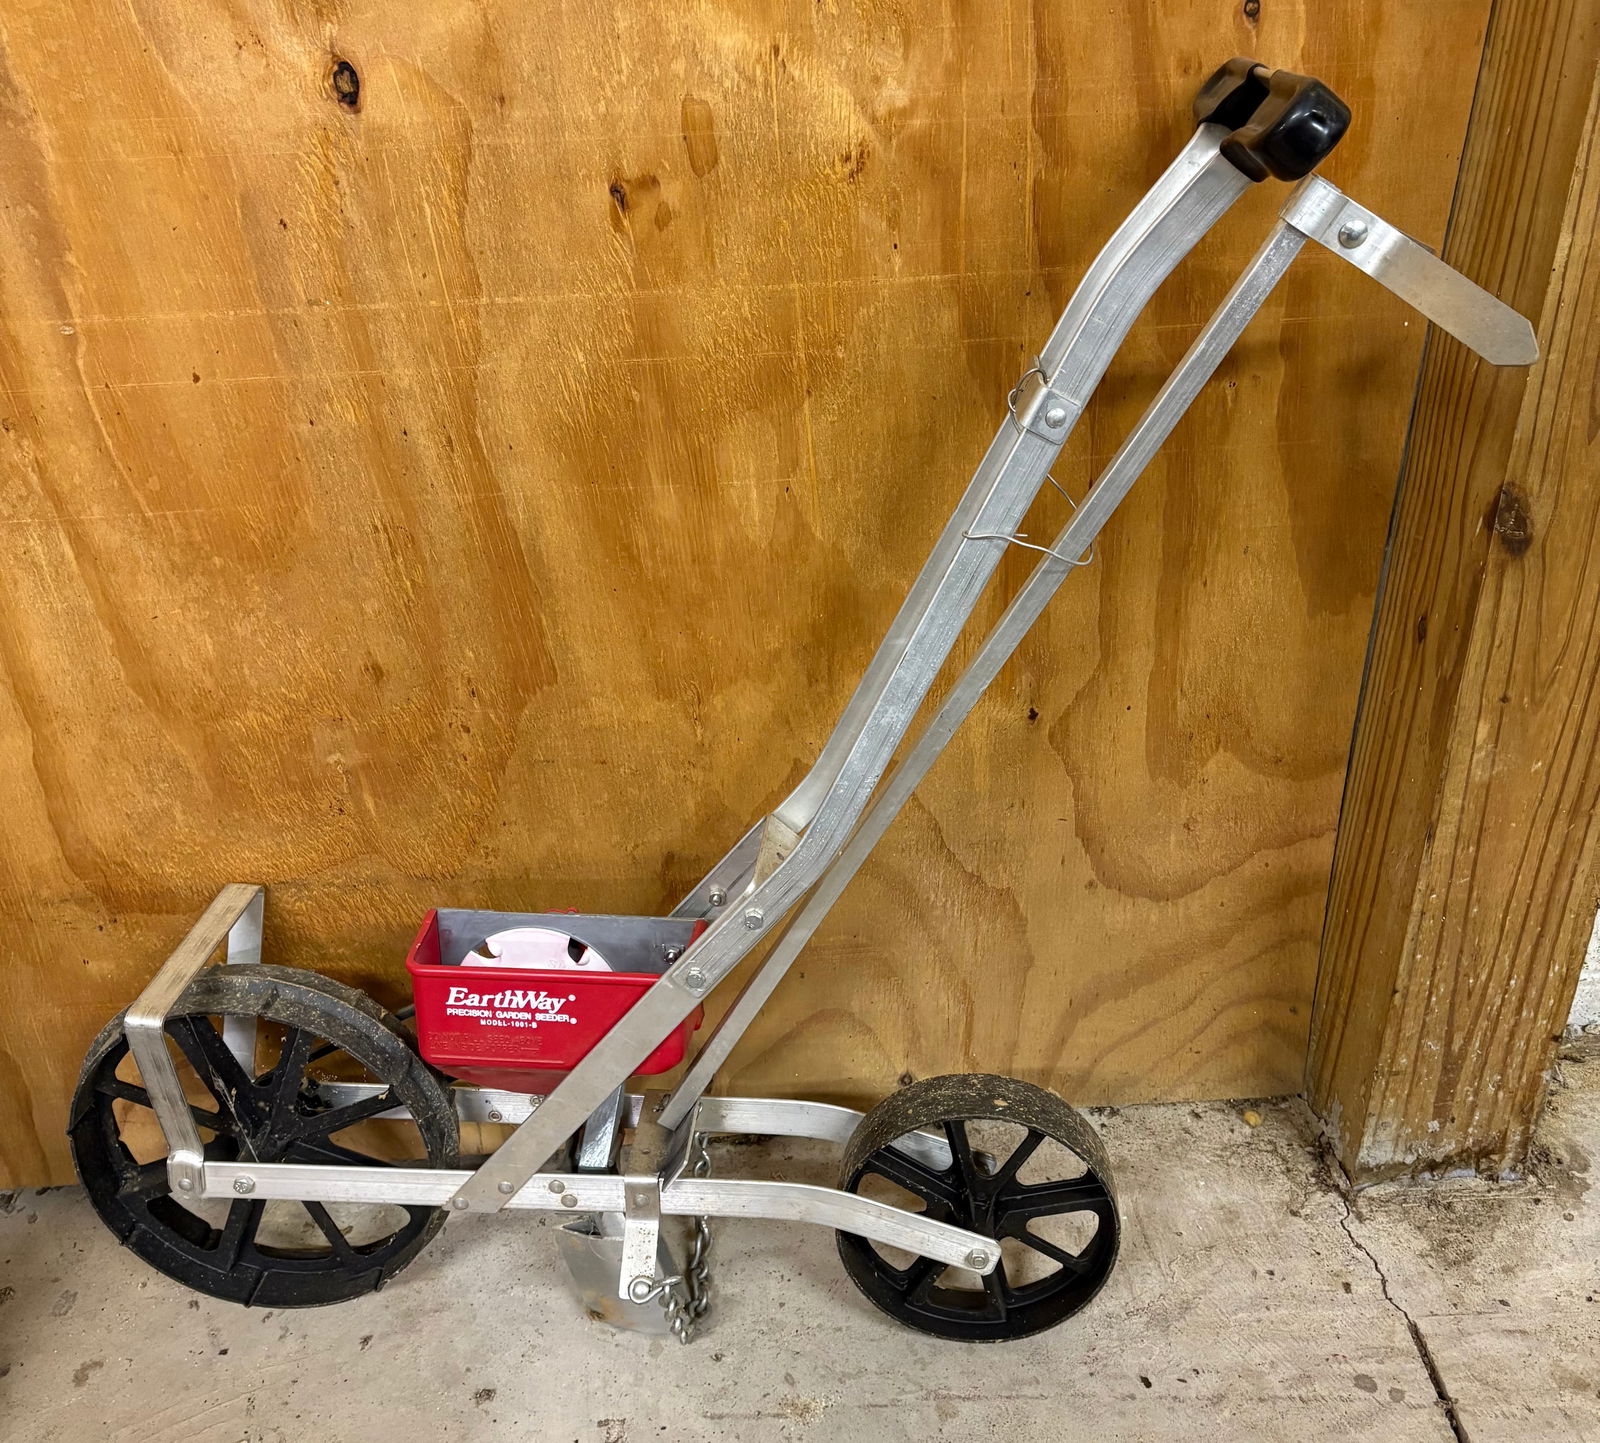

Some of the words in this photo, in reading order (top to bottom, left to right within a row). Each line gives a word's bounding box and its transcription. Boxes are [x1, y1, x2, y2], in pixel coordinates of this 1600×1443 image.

[446, 986, 566, 1013] EarthWay
[446, 1007, 492, 1018] PRECISION
[495, 1011, 531, 1020] GARDEN
[534, 1012, 570, 1022] SEEDER
[487, 1034, 511, 1043] SEED
